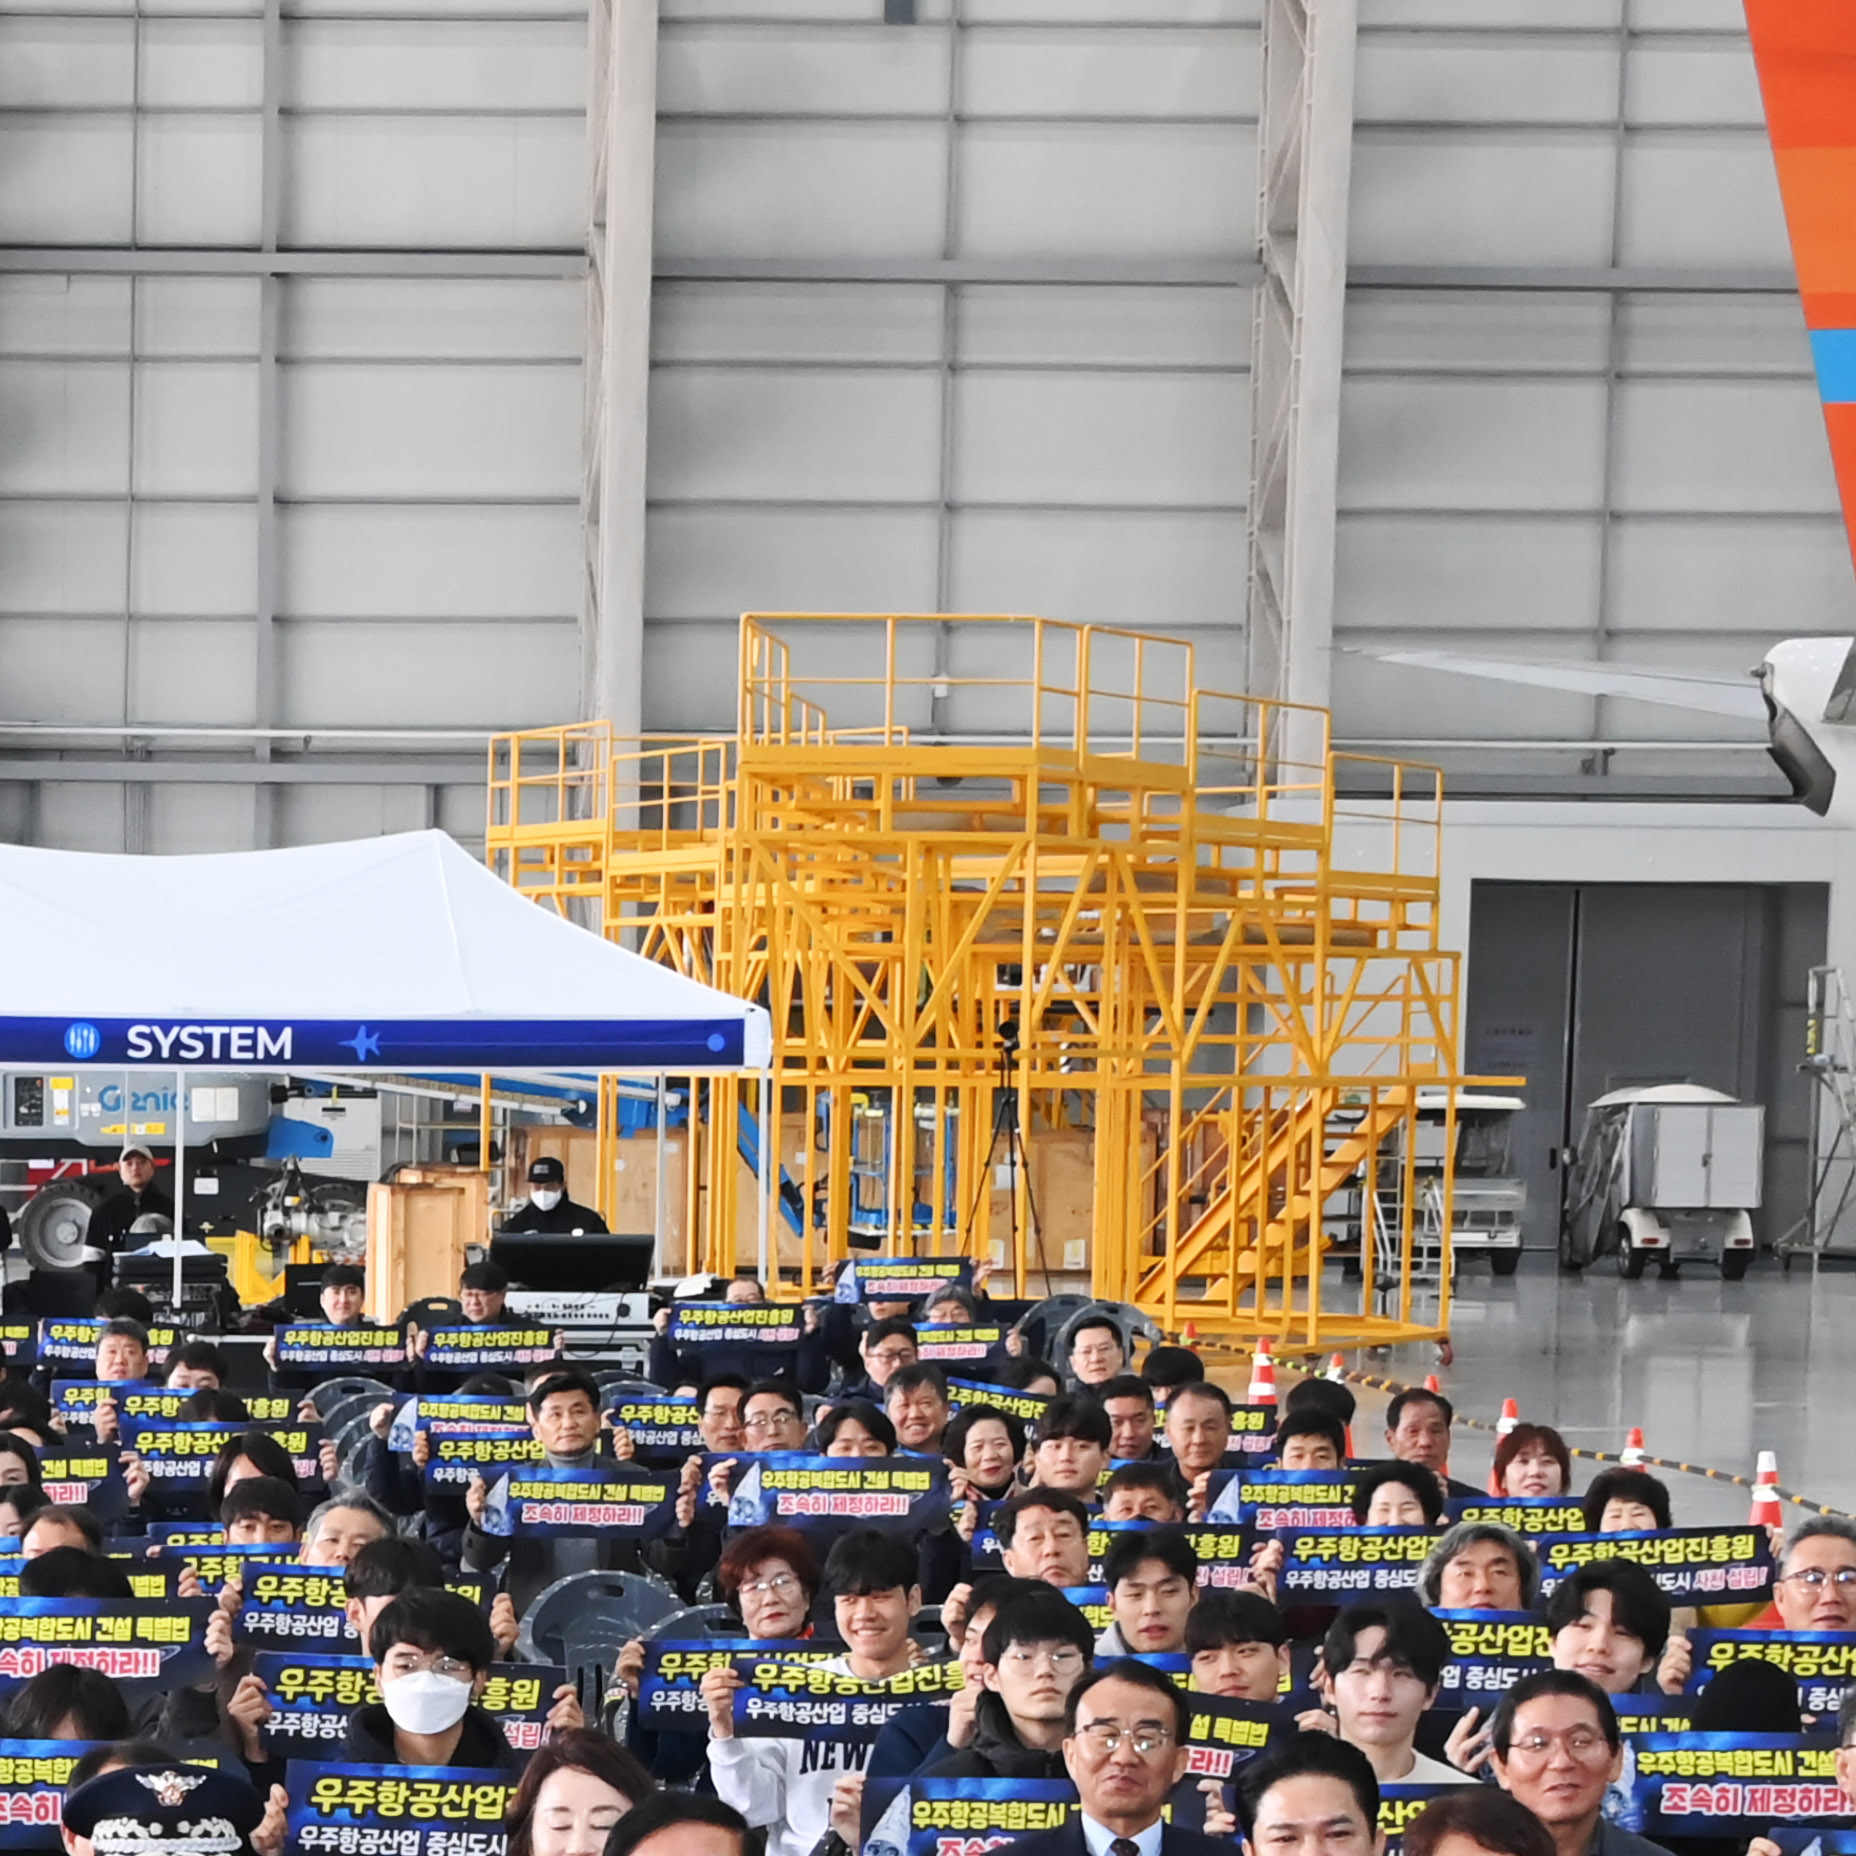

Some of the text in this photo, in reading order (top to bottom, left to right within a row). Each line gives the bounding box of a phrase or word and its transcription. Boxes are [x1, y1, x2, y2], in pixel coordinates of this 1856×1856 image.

[126, 1025, 293, 1060] SYSTEM
[678, 1308, 793, 1325] 우주항공산업진흥원
[284, 1330, 398, 1346] 우주항공산업진흥원
[433, 1330, 548, 1347] 우주항공산업진흥원
[438, 1441, 546, 1461] 우주항공산업
[761, 1470, 861, 1490] 우주항공복합도시
[863, 1470, 889, 1489] 건설
[521, 1503, 644, 1525] 조속히 제정하라!!
[777, 1493, 910, 1515] 조속히 제정하라!!
[1285, 1568, 1371, 1591] 우주항공산업
[1725, 1568, 1765, 1588] 설립!
[95, 1617, 132, 1641] 건설
[136, 1616, 190, 1642] 특별법
[244, 1614, 339, 1637] 우주항공산업
[746, 1699, 846, 1726] 우주항공산업
[1212, 1717, 1269, 1748] 특별법
[1637, 1750, 1836, 1777] 우주항공복합도시 건설
[311, 1778, 508, 1820] 우주항공산업
[1661, 1784, 1742, 1815] 조속히
[912, 1800, 1065, 1830] 우주항공복합도시
[298, 1826, 419, 1856] 우주항공산업
